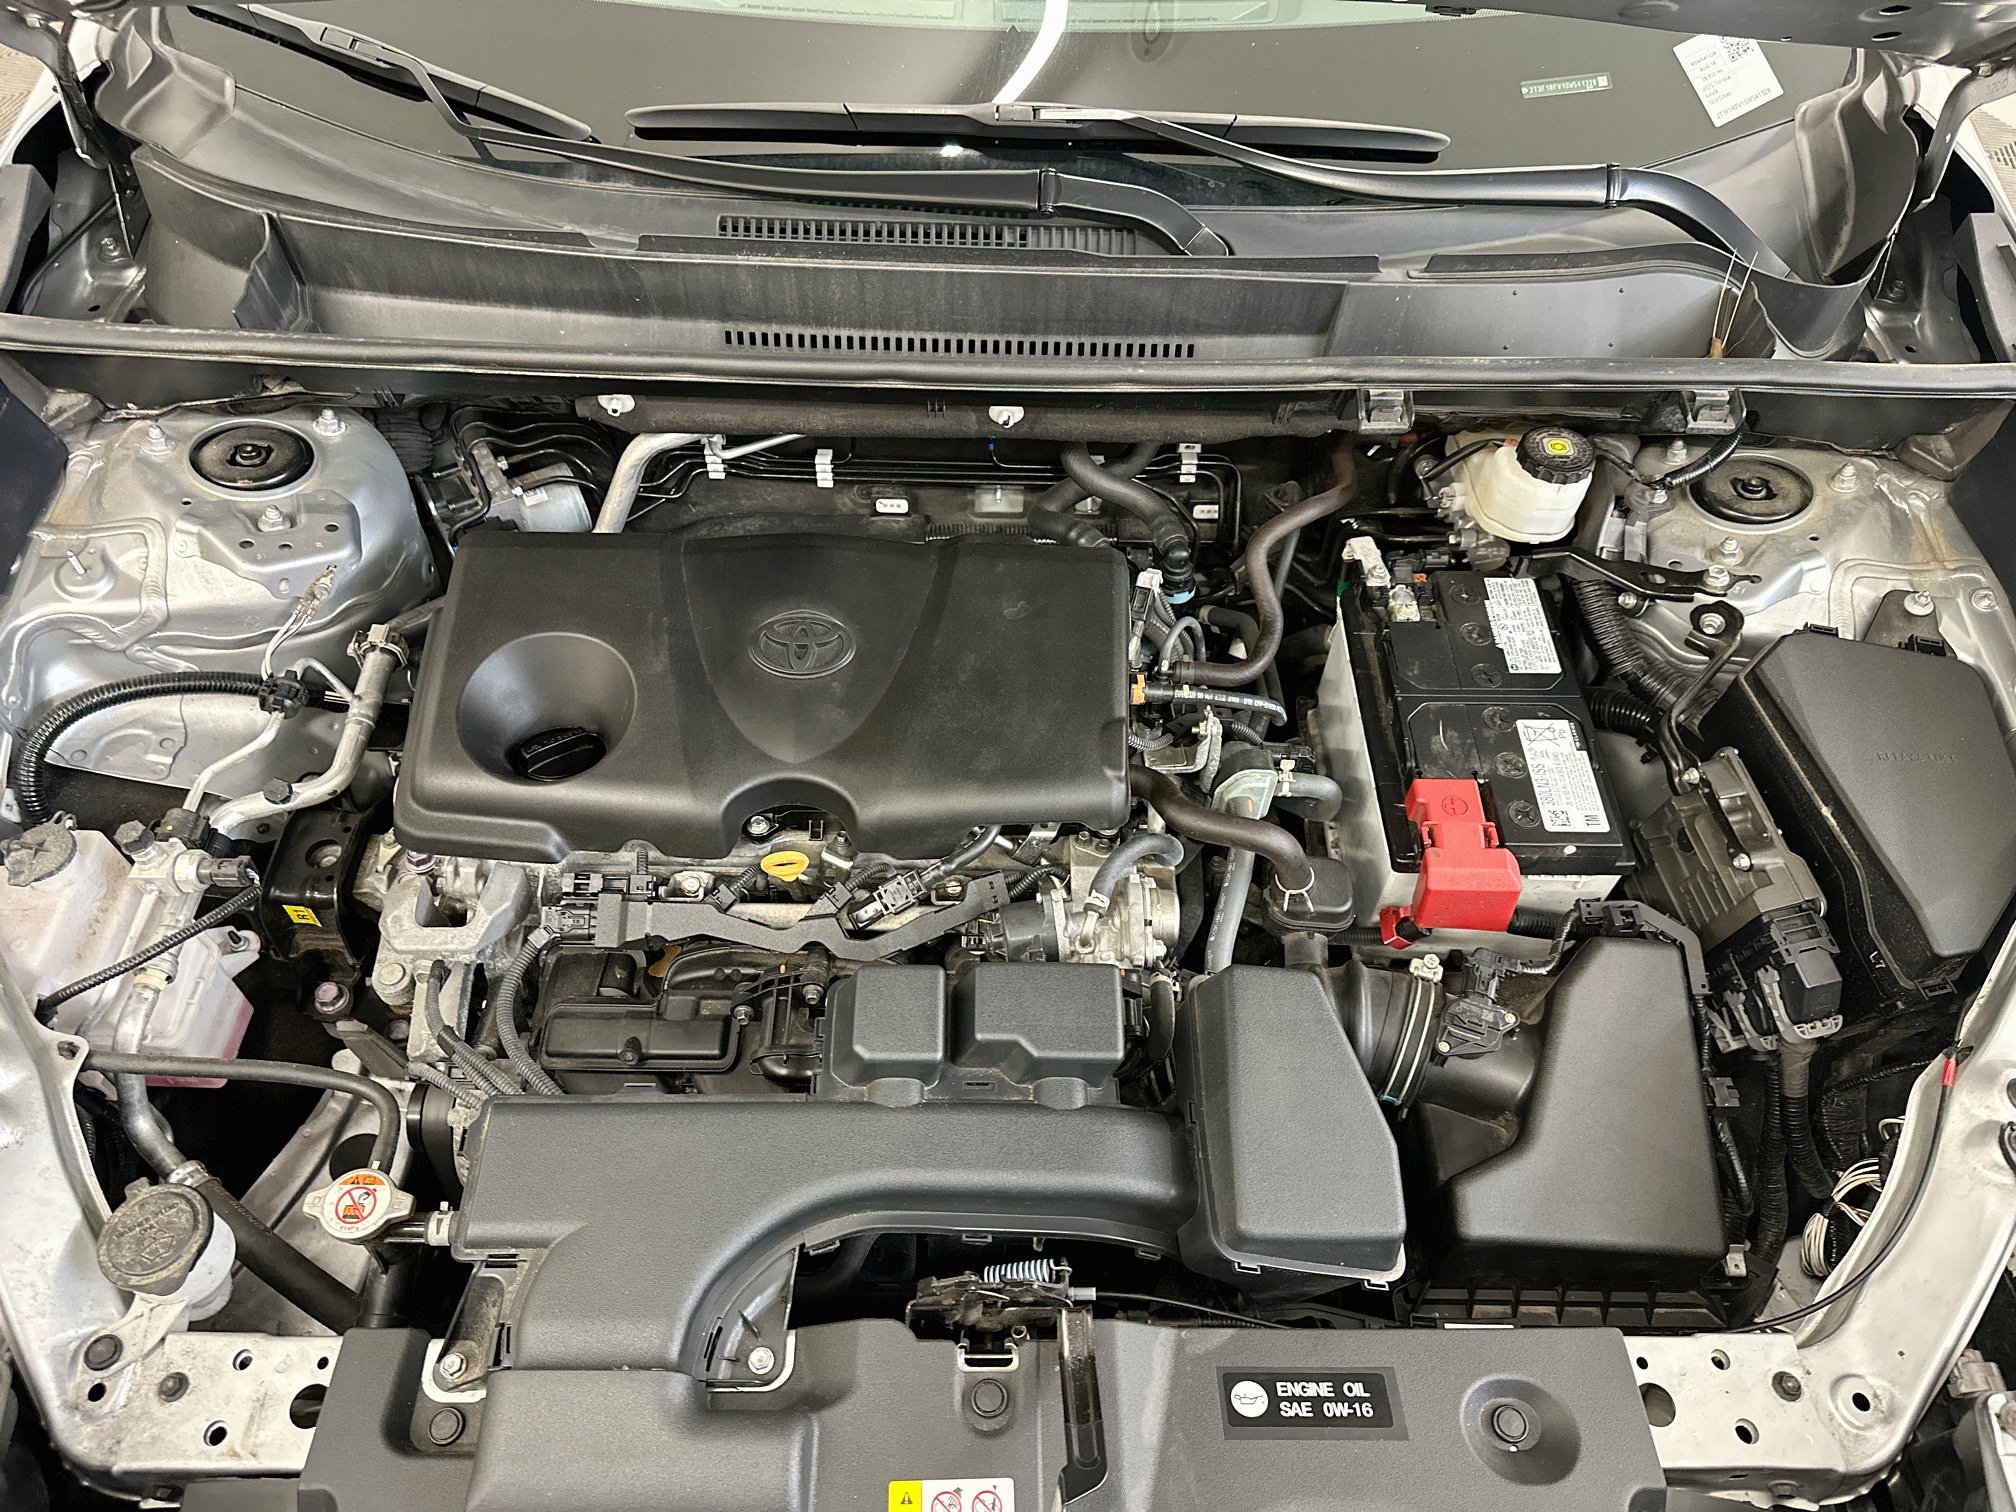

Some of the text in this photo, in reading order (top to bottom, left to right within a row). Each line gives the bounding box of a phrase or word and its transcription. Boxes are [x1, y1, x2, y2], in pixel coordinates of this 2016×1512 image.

[1275, 1381, 1371, 1398] ENGINE OIL
[1279, 1401, 1374, 1418] SAE 0W-16
